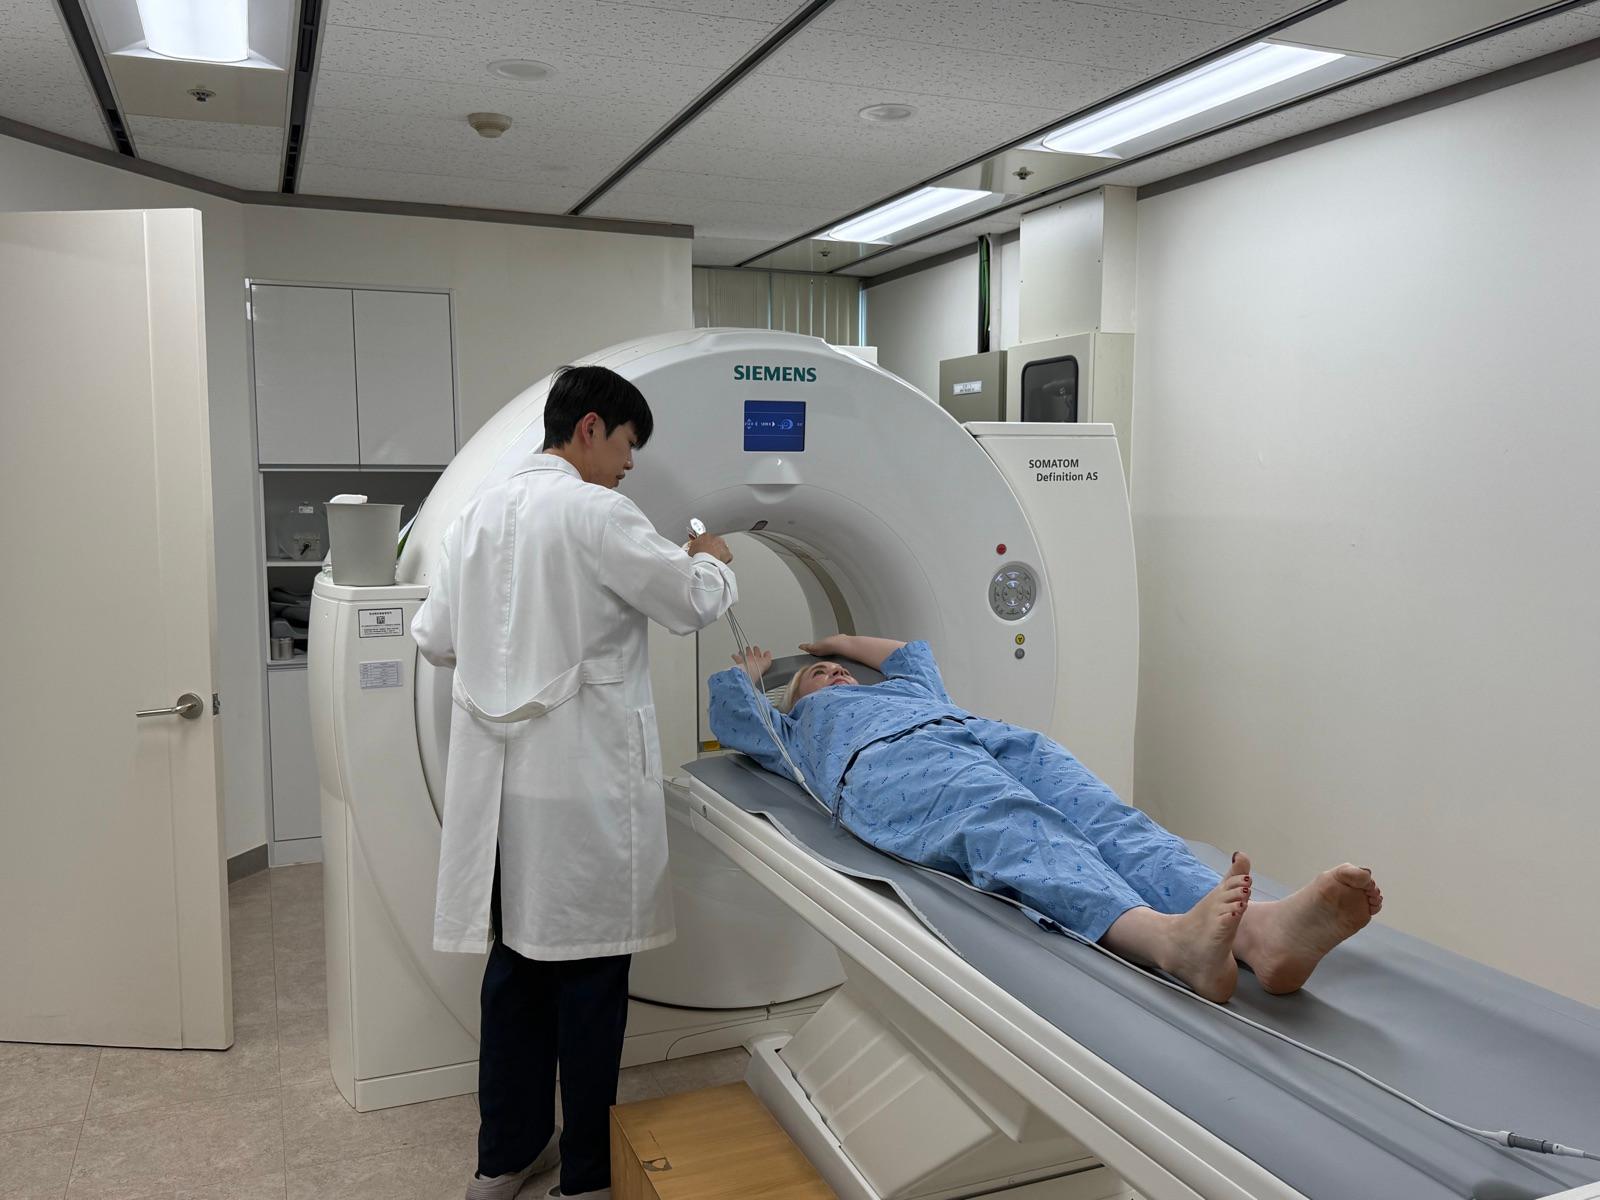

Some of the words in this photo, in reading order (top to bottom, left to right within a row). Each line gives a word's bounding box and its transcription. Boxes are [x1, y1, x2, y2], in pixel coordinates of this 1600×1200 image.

[733, 365, 817, 382] SIEMENS
[1028, 459, 1079, 469] SOMATOM
[1036, 472, 1083, 481] Definition
[1086, 472, 1098, 480] AS
